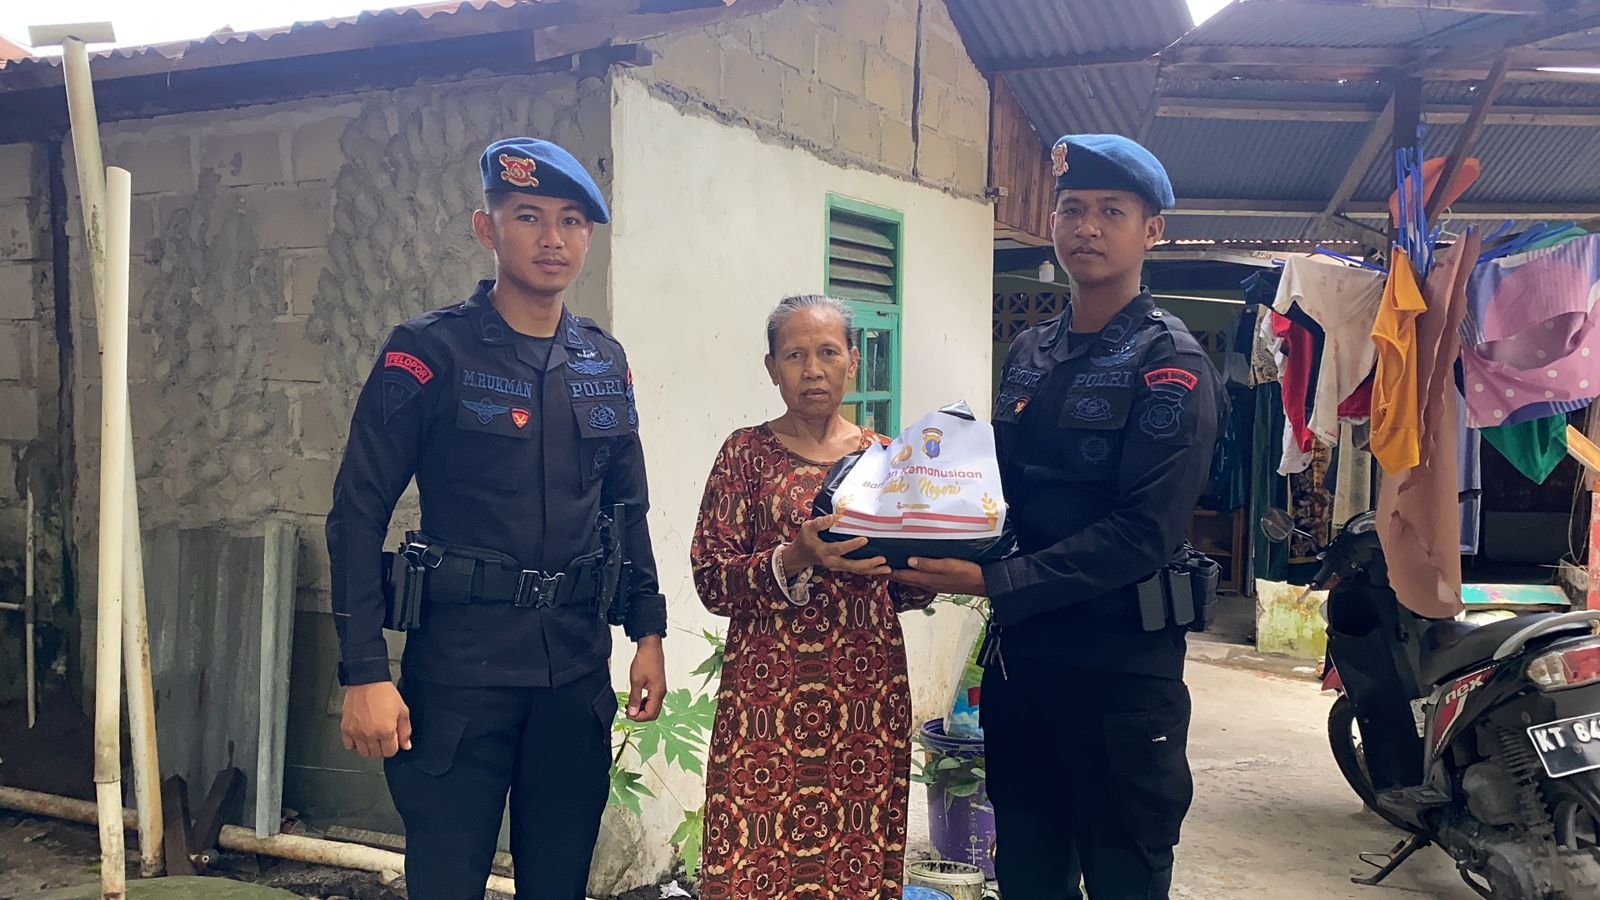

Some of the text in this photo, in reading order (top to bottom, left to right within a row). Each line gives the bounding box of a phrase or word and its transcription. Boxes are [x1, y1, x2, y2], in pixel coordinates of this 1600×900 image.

[389, 355, 428, 378] PELOPOR
[463, 370, 533, 399] M.RUKMAN
[569, 380, 623, 397] POLRI
[1072, 371, 1132, 388] POLRI
[900, 465, 983, 479] Kemanusiaan
[1534, 726, 1566, 752] KT
